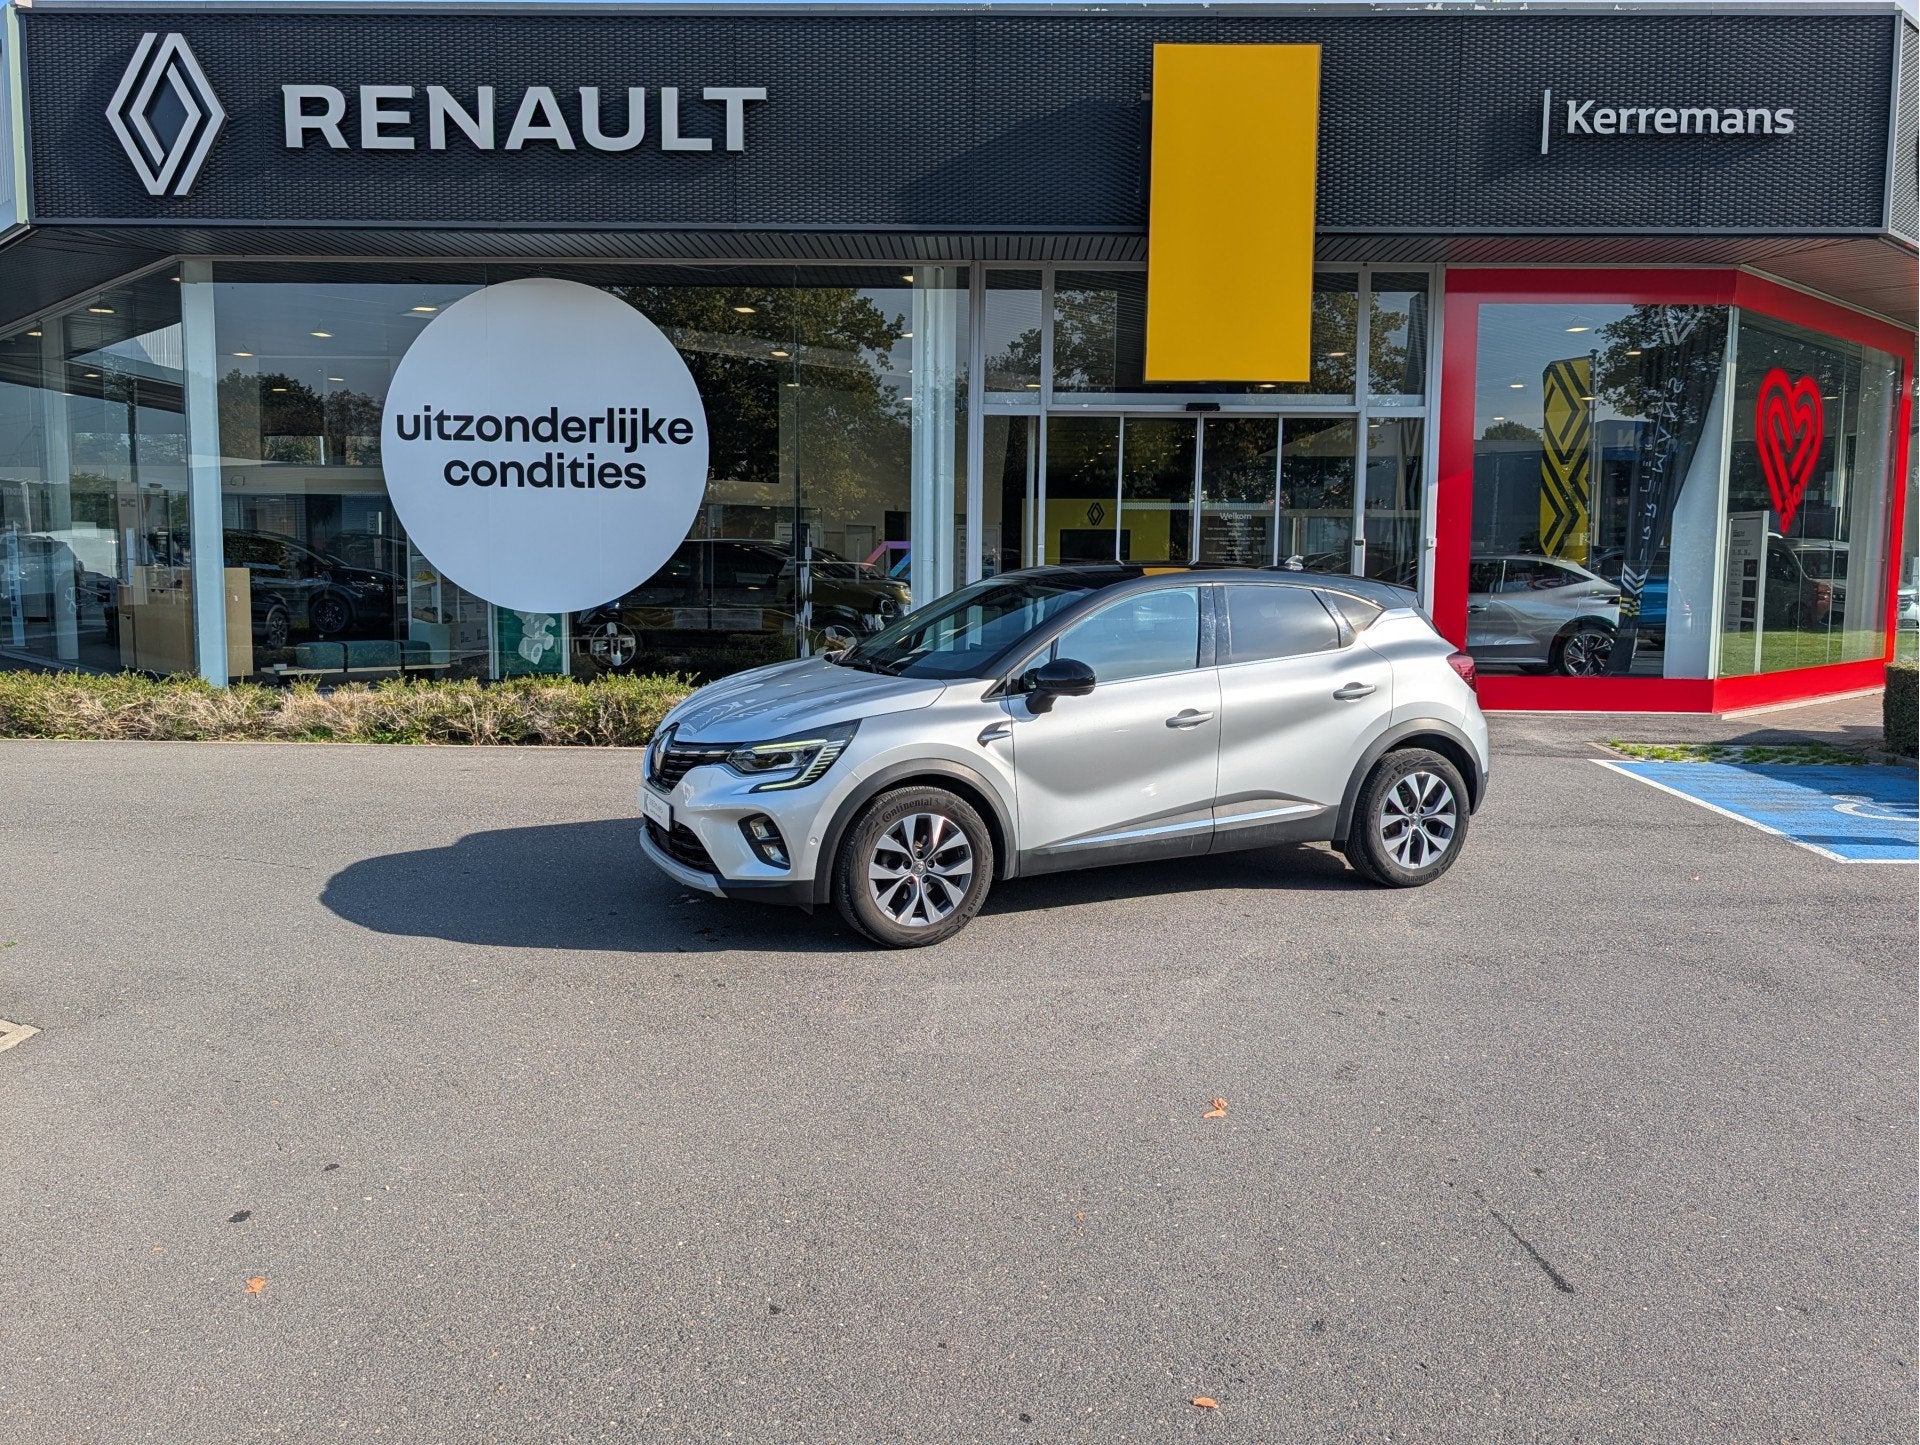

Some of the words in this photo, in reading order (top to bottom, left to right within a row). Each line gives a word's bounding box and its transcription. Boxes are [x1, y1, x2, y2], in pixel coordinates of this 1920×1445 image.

[282, 84, 768, 152] RENAULT
[1566, 99, 1795, 135] Kerremans
[396, 405, 694, 454] uitzonderlijke
[443, 451, 647, 490] condities
[1219, 512, 1252, 521] Welkom
[882, 796, 933, 823] Continental
